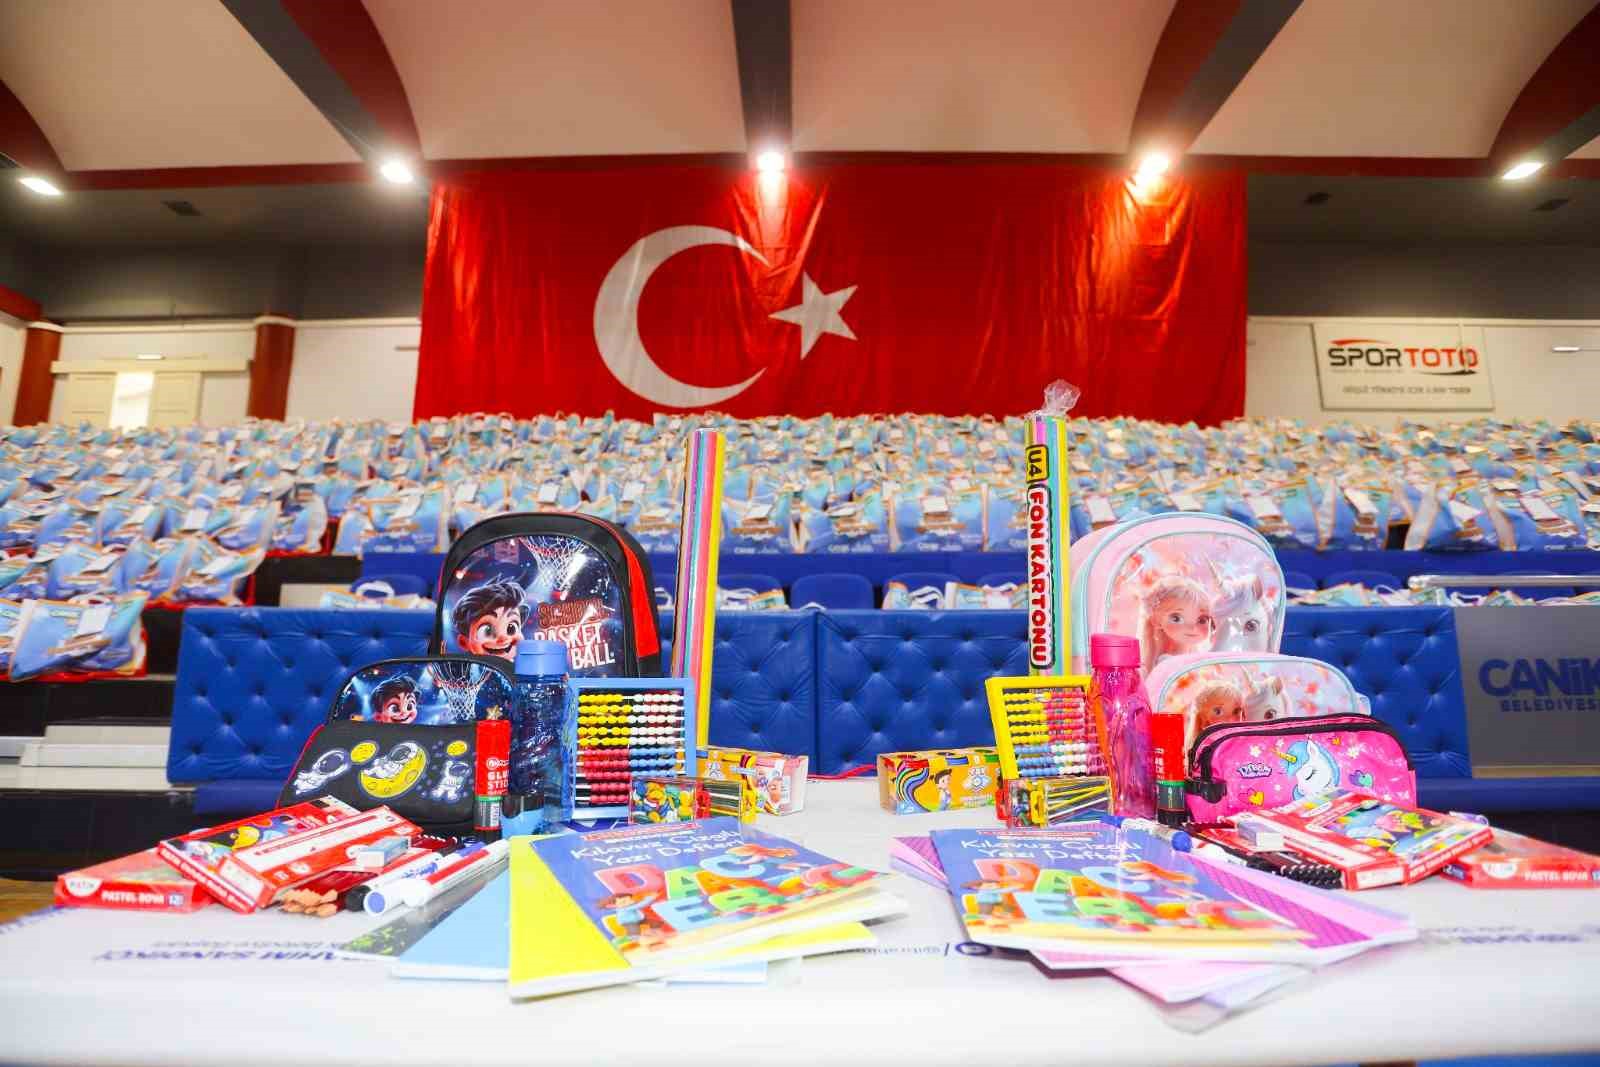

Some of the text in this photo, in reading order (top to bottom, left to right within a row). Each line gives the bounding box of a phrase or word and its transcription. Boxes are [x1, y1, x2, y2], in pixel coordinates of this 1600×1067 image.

[1030, 491, 1046, 661] FON KARTONU
[571, 642, 616, 670] BALL
[1501, 698, 1600, 712] BELEDİYES
